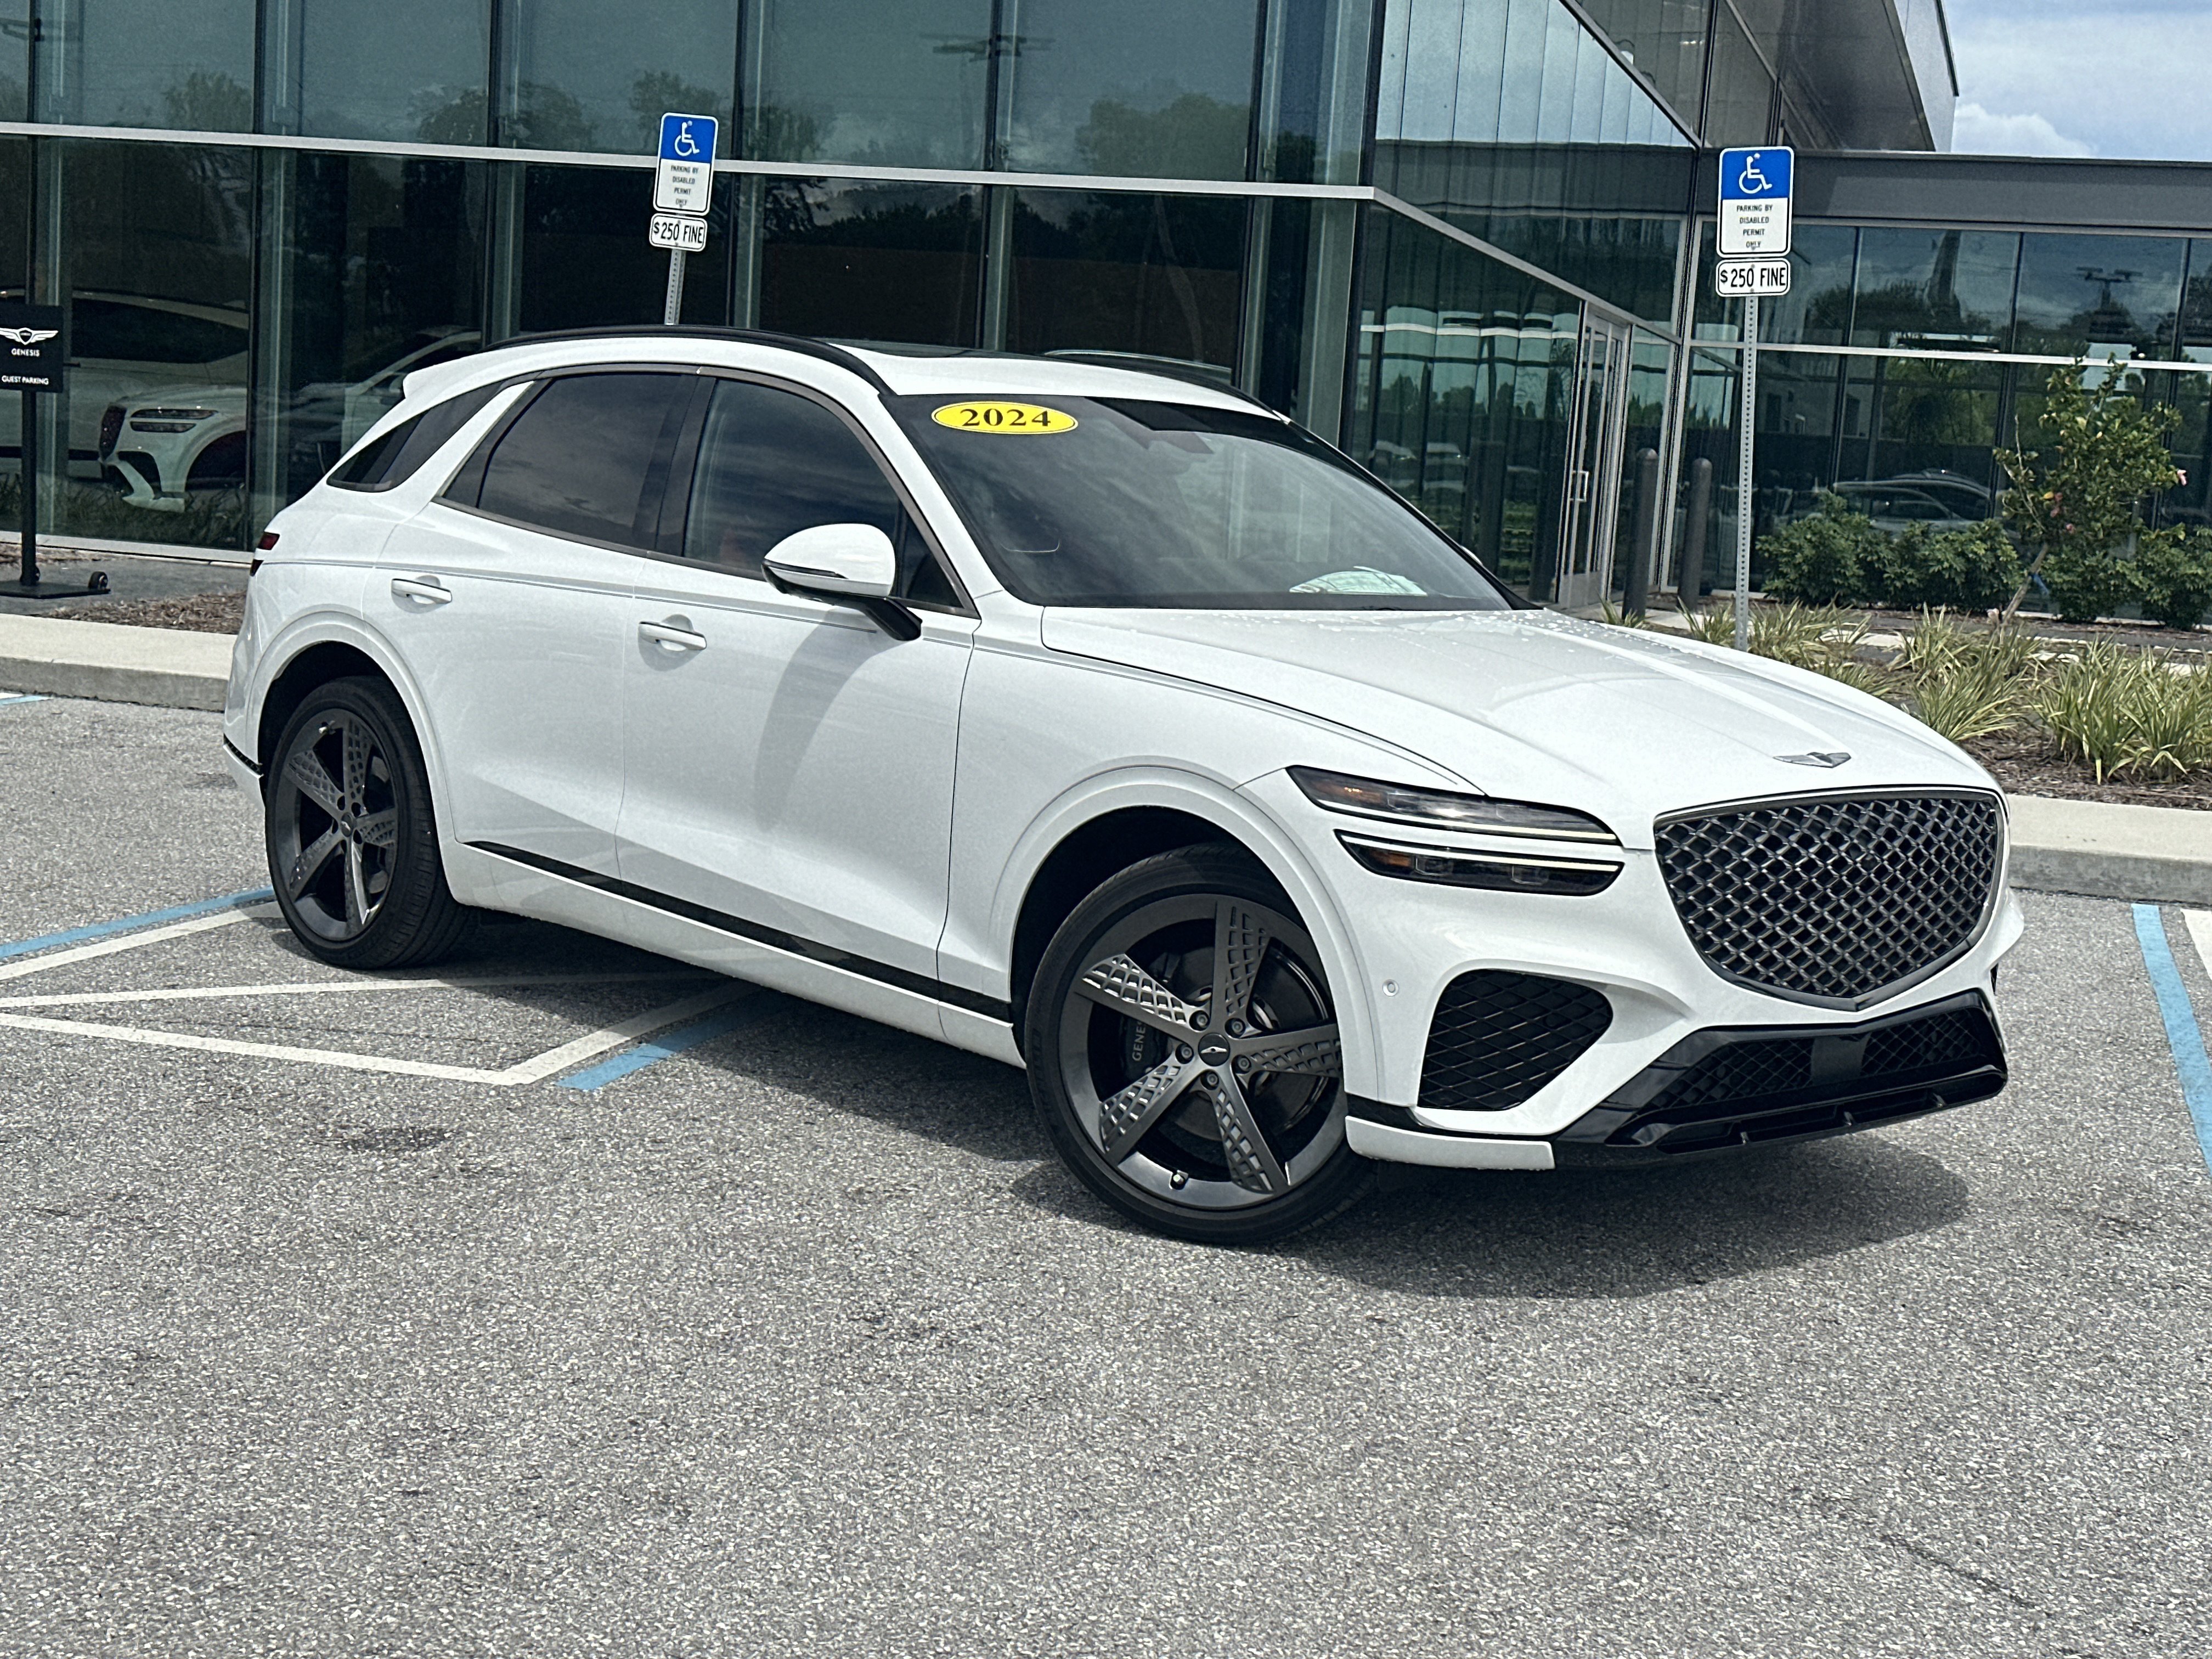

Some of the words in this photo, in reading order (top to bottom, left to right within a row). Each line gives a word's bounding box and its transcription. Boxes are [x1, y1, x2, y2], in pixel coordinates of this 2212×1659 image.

[684, 225, 703, 243] FINE
[1760, 268, 1786, 286] FINE
[11, 348, 40, 357] GENESIS
[22, 377, 49, 386] PARKING
[960, 409, 1051, 427] 2024
